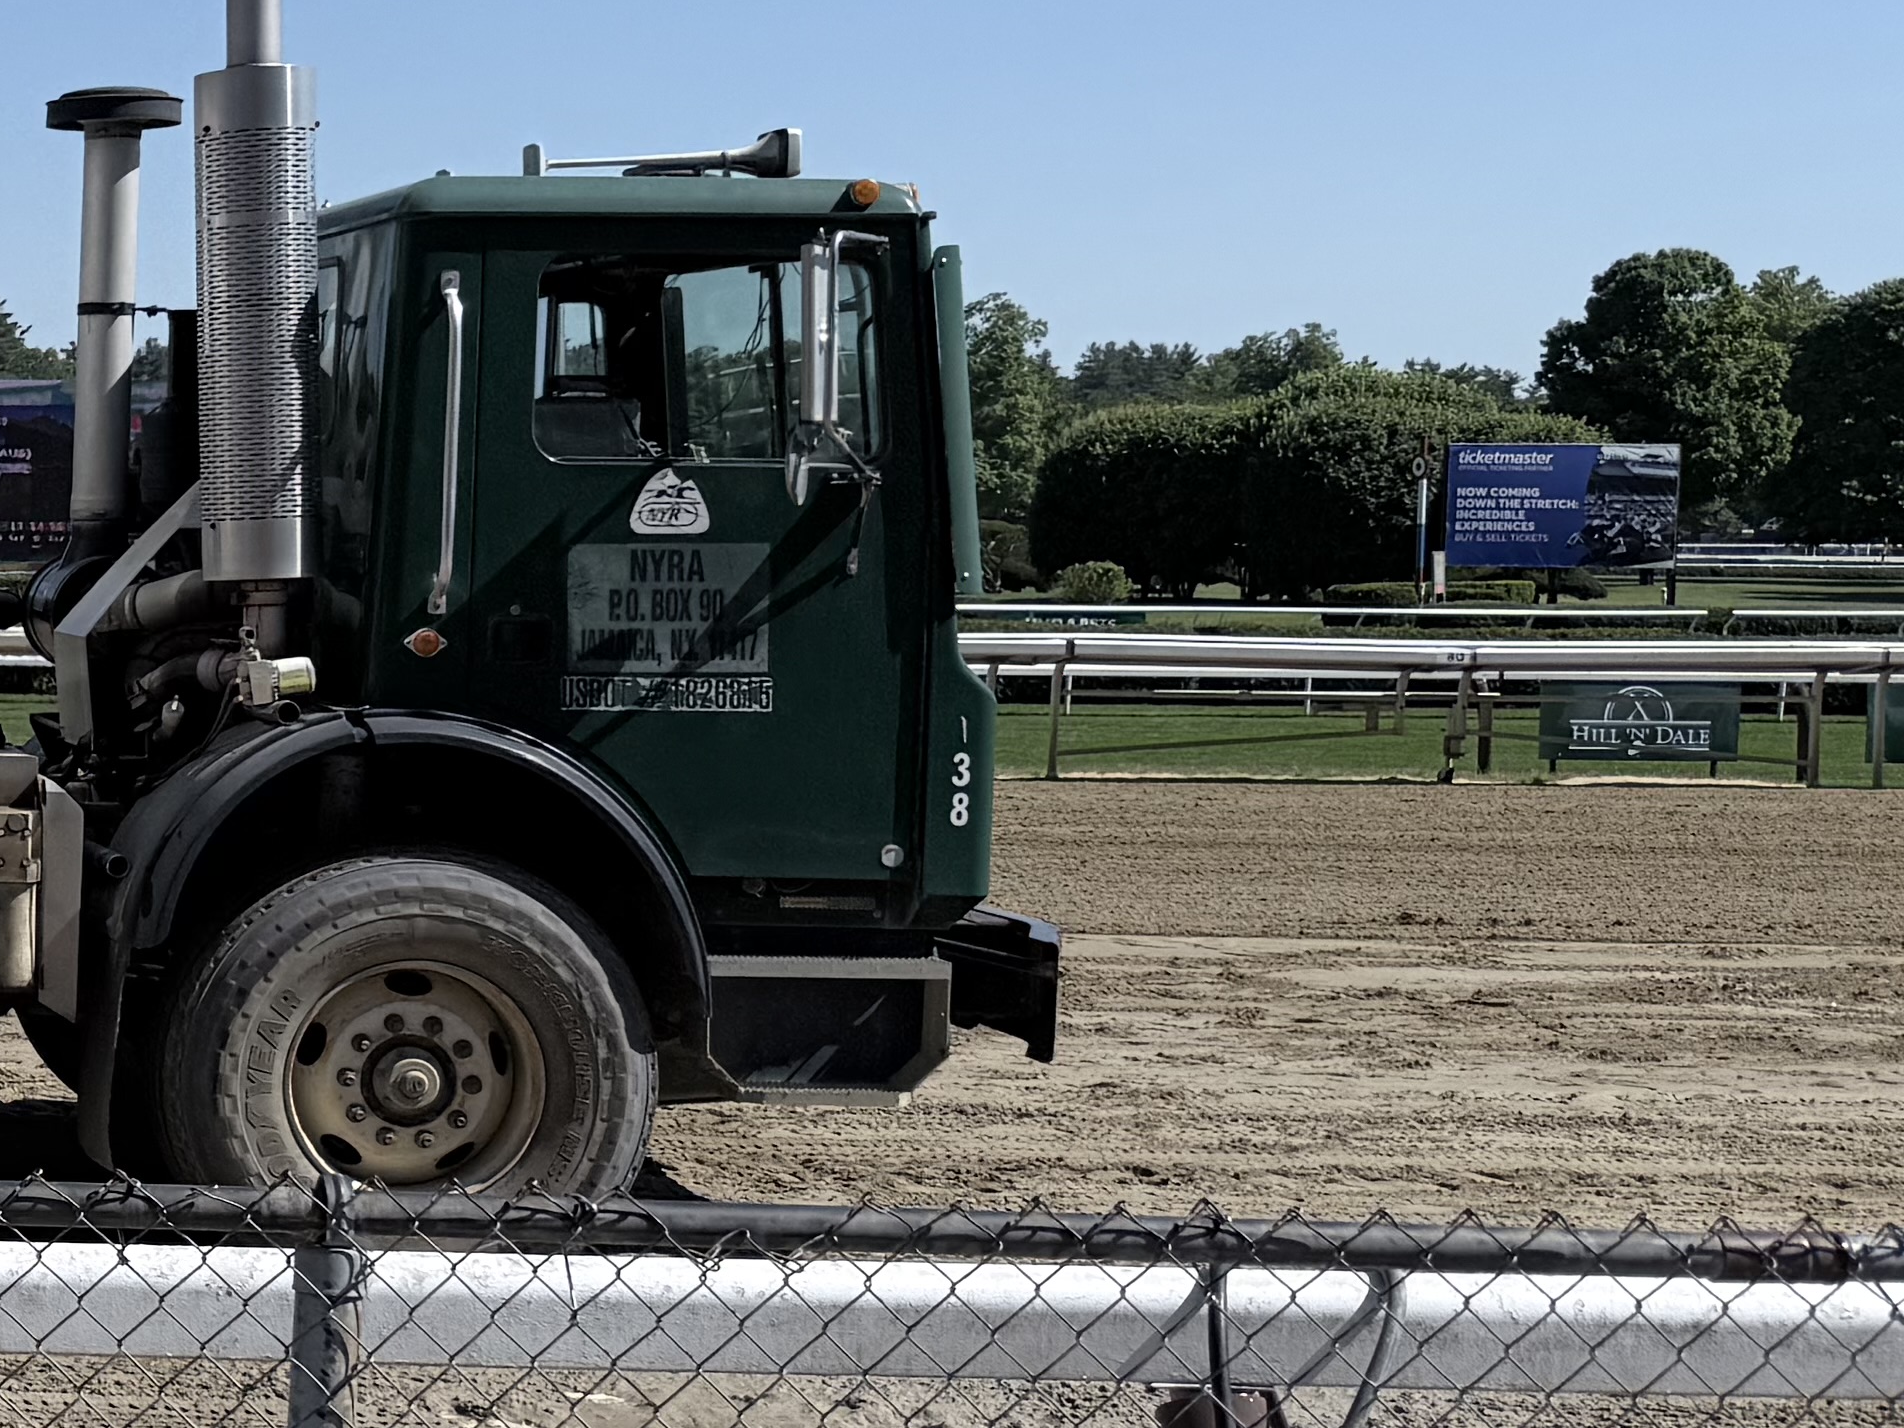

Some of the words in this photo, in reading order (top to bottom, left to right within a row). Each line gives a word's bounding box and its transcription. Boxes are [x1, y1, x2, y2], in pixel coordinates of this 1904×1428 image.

[1458, 449, 1554, 465] ticketmaster
[1456, 487, 1488, 497] NOW
[1490, 487, 1540, 498] COMING
[1456, 498, 1496, 508] DOWN
[1498, 499, 1521, 509] THE
[1523, 499, 1580, 509] STRETCH:
[1455, 510, 1526, 520] INCREDIBLE
[1455, 521, 1535, 531] EXPERIENCES
[1454, 533, 1473, 542] BUY
[1485, 533, 1507, 542] SELL
[1510, 533, 1549, 542] TICKETS
[629, 549, 706, 583] NYRA
[608, 588, 646, 622] P.O.
[651, 588, 693, 623] BOX
[699, 588, 724, 623] 90
[1571, 725, 1622, 744] HILL
[1655, 726, 1711, 745] DALE
